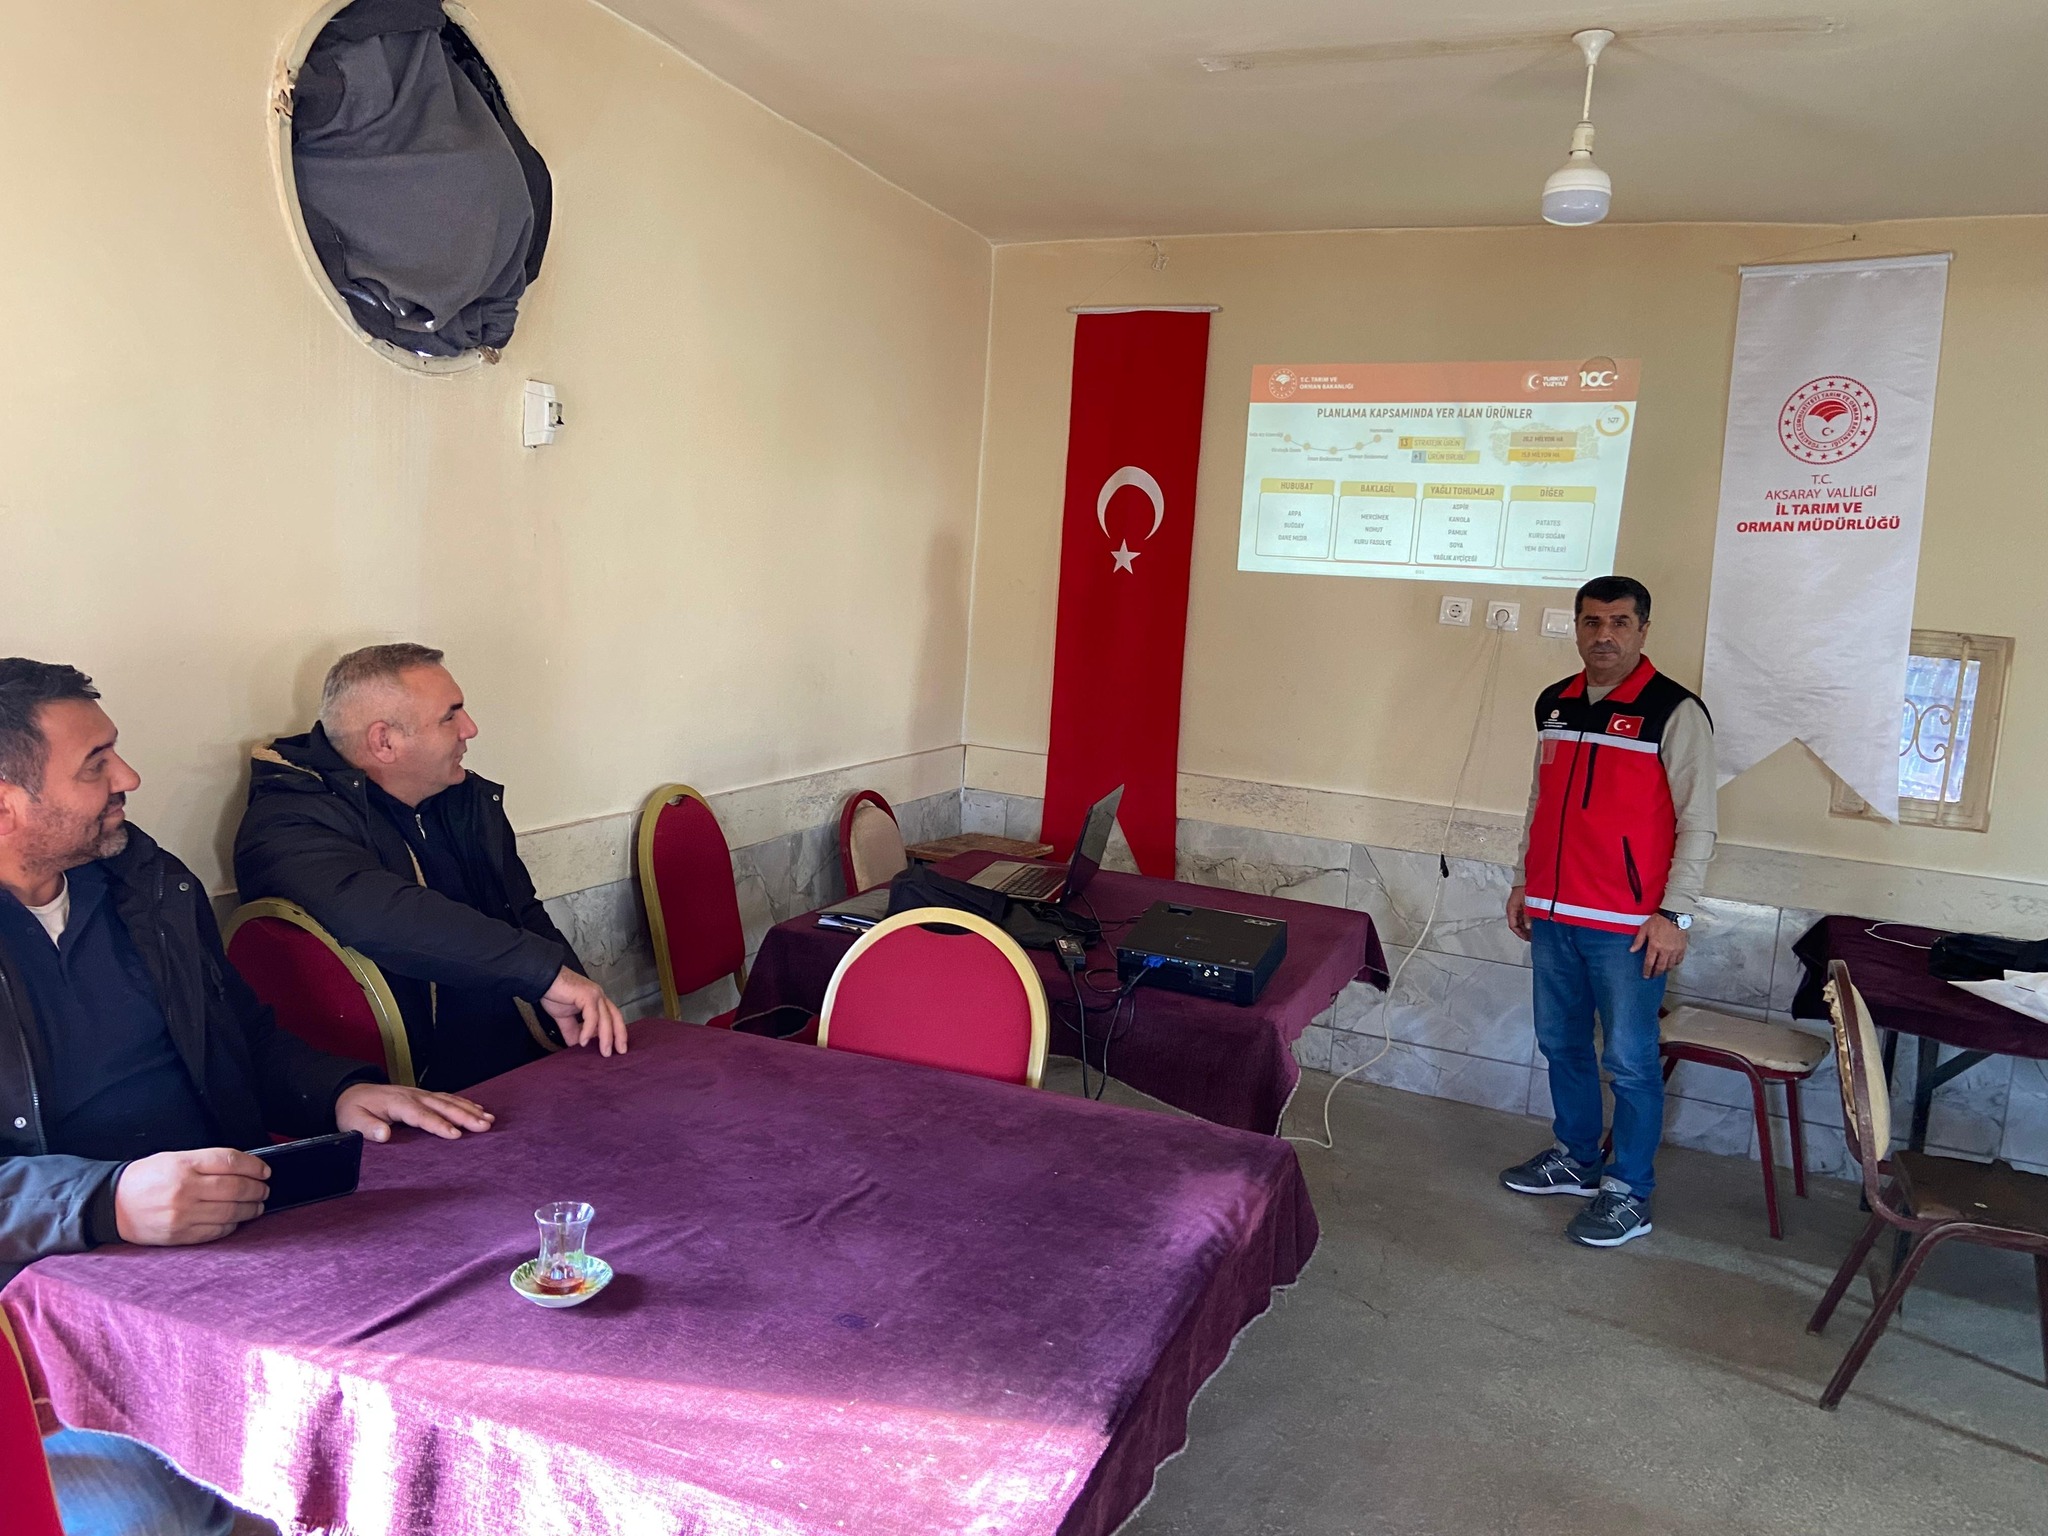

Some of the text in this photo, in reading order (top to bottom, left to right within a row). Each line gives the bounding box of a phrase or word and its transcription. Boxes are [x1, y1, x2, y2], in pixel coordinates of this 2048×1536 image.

[1317, 406, 1533, 419] PLANLAMA KAPSAMINDA YER ALAN ÜRÜNLER
[1811, 474, 1832, 485] T.C.
[1280, 482, 1314, 490] HUBUBAT
[1360, 483, 1395, 493] BAKLAGİL
[1430, 484, 1495, 496] YAĞLI TOHUMLAR
[1540, 487, 1564, 498] DİĞER
[1765, 485, 1877, 500] AKSARAY VALİLİĞİ
[1776, 502, 1863, 516] İL TARIM VE
[1535, 519, 1561, 527] PATATES
[1737, 515, 1901, 533] ORMAN MÜDÜRLÜĞÜ
